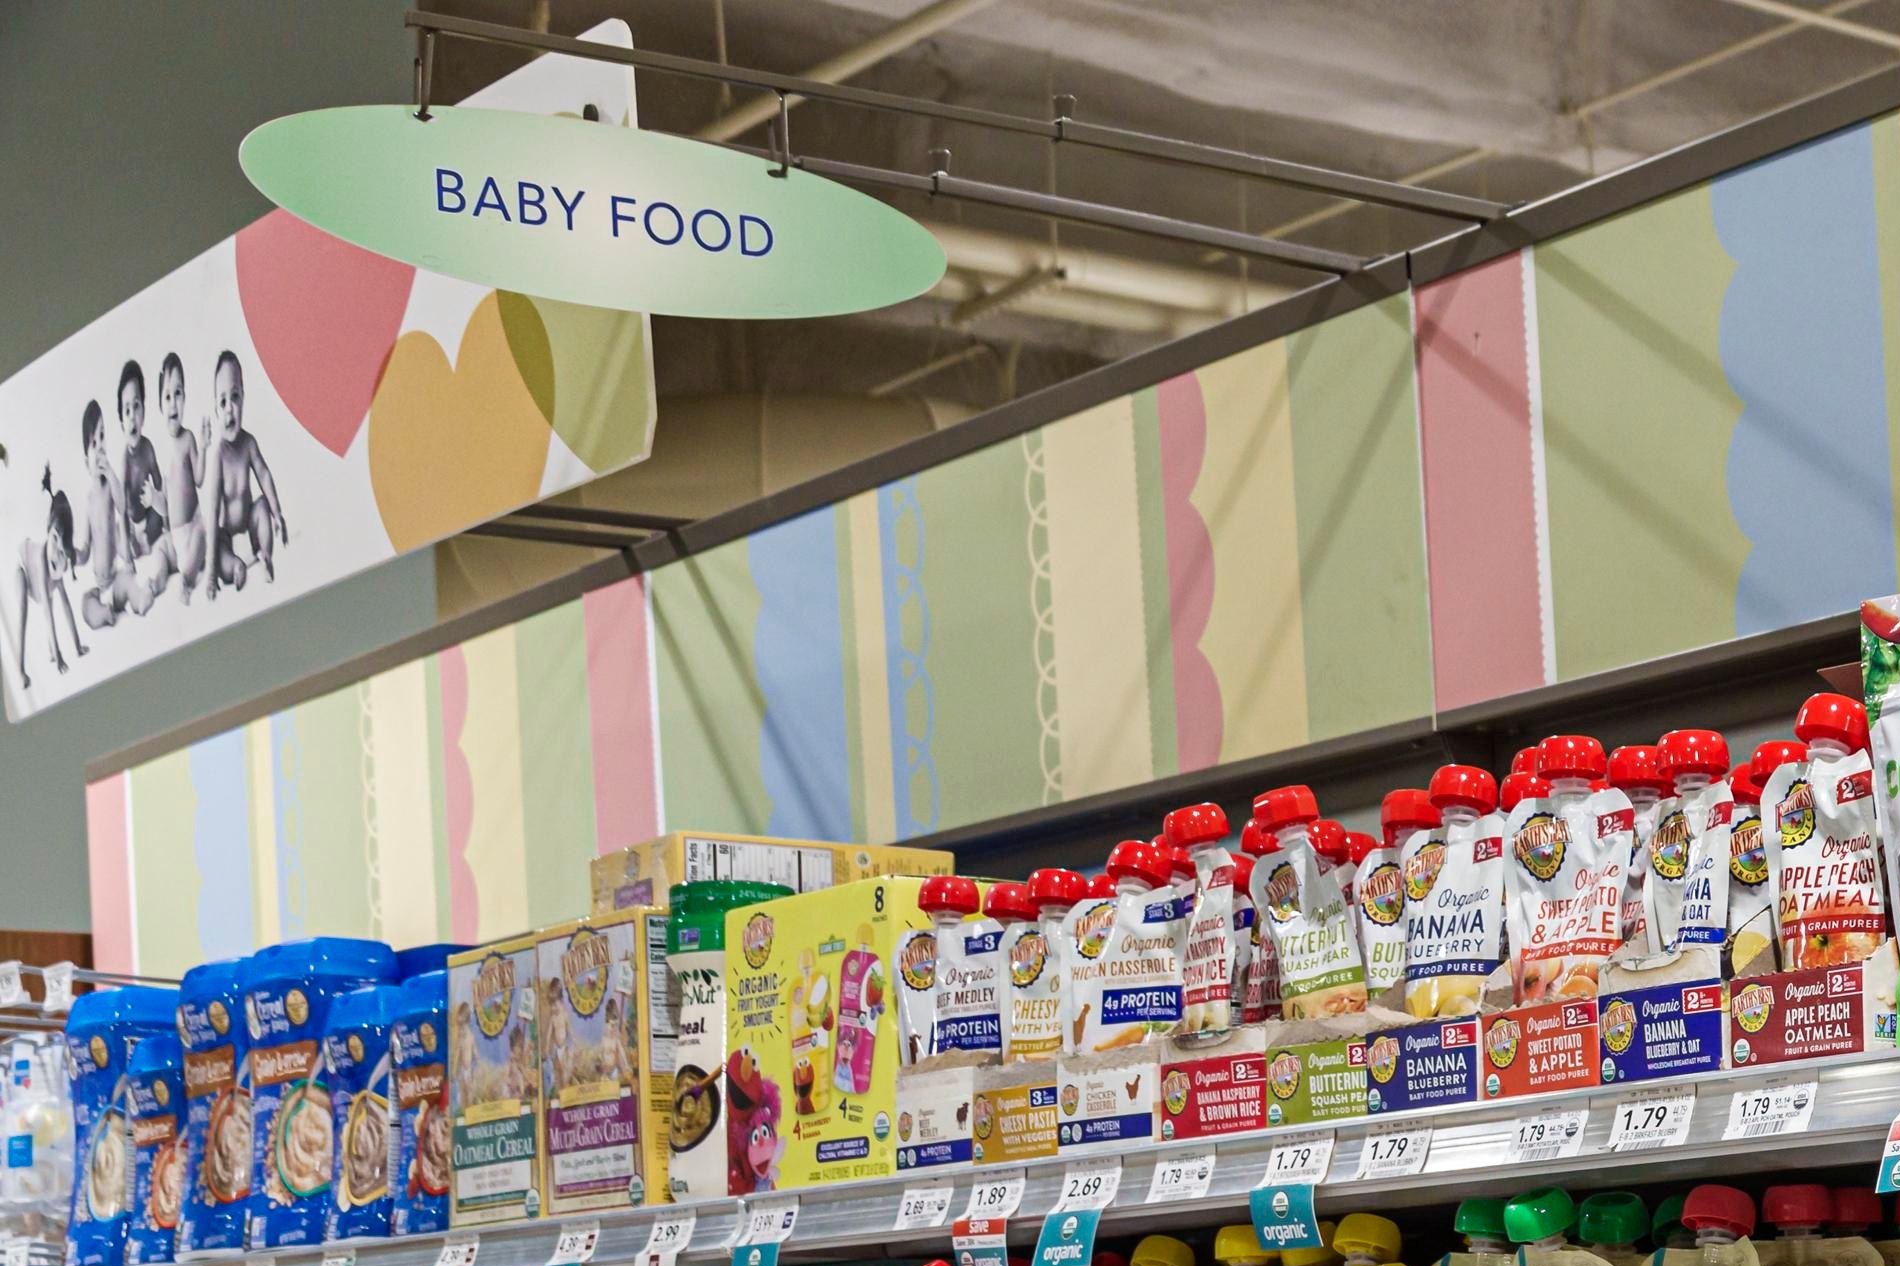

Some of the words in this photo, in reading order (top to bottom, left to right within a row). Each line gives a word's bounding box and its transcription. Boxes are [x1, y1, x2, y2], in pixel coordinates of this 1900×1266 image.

[434, 167, 584, 232] BABY
[609, 197, 775, 258] FOOD
[1780, 890, 1880, 917] OATMEAL
[1408, 912, 1485, 941] BANANA
[955, 987, 995, 1004] MEDLEY
[1121, 991, 1176, 1010] PROTEIN
[1785, 1006, 1815, 1026] APPLE
[1818, 1001, 1850, 1021] PEACH
[1785, 1023, 1851, 1043] OATMEAL
[1528, 1039, 1550, 1055] SWEET
[1551, 1033, 1582, 1051] POTATO
[1406, 1053, 1467, 1078] BANANA
[1540, 1052, 1583, 1072] APPLE
[1407, 1073, 1467, 1090] BLUEBERRY
[1740, 1096, 1770, 1117] 1.79
[1624, 1105, 1667, 1132] 1.79
[1275, 1149, 1311, 1169] 1.79
[1371, 1138, 1409, 1160] 1.79
[977, 1186, 1006, 1206] 1.89
[1068, 1177, 1102, 1198] 2.69
[1264, 1221, 1308, 1241] organic
[1043, 1242, 1083, 1263] organic
